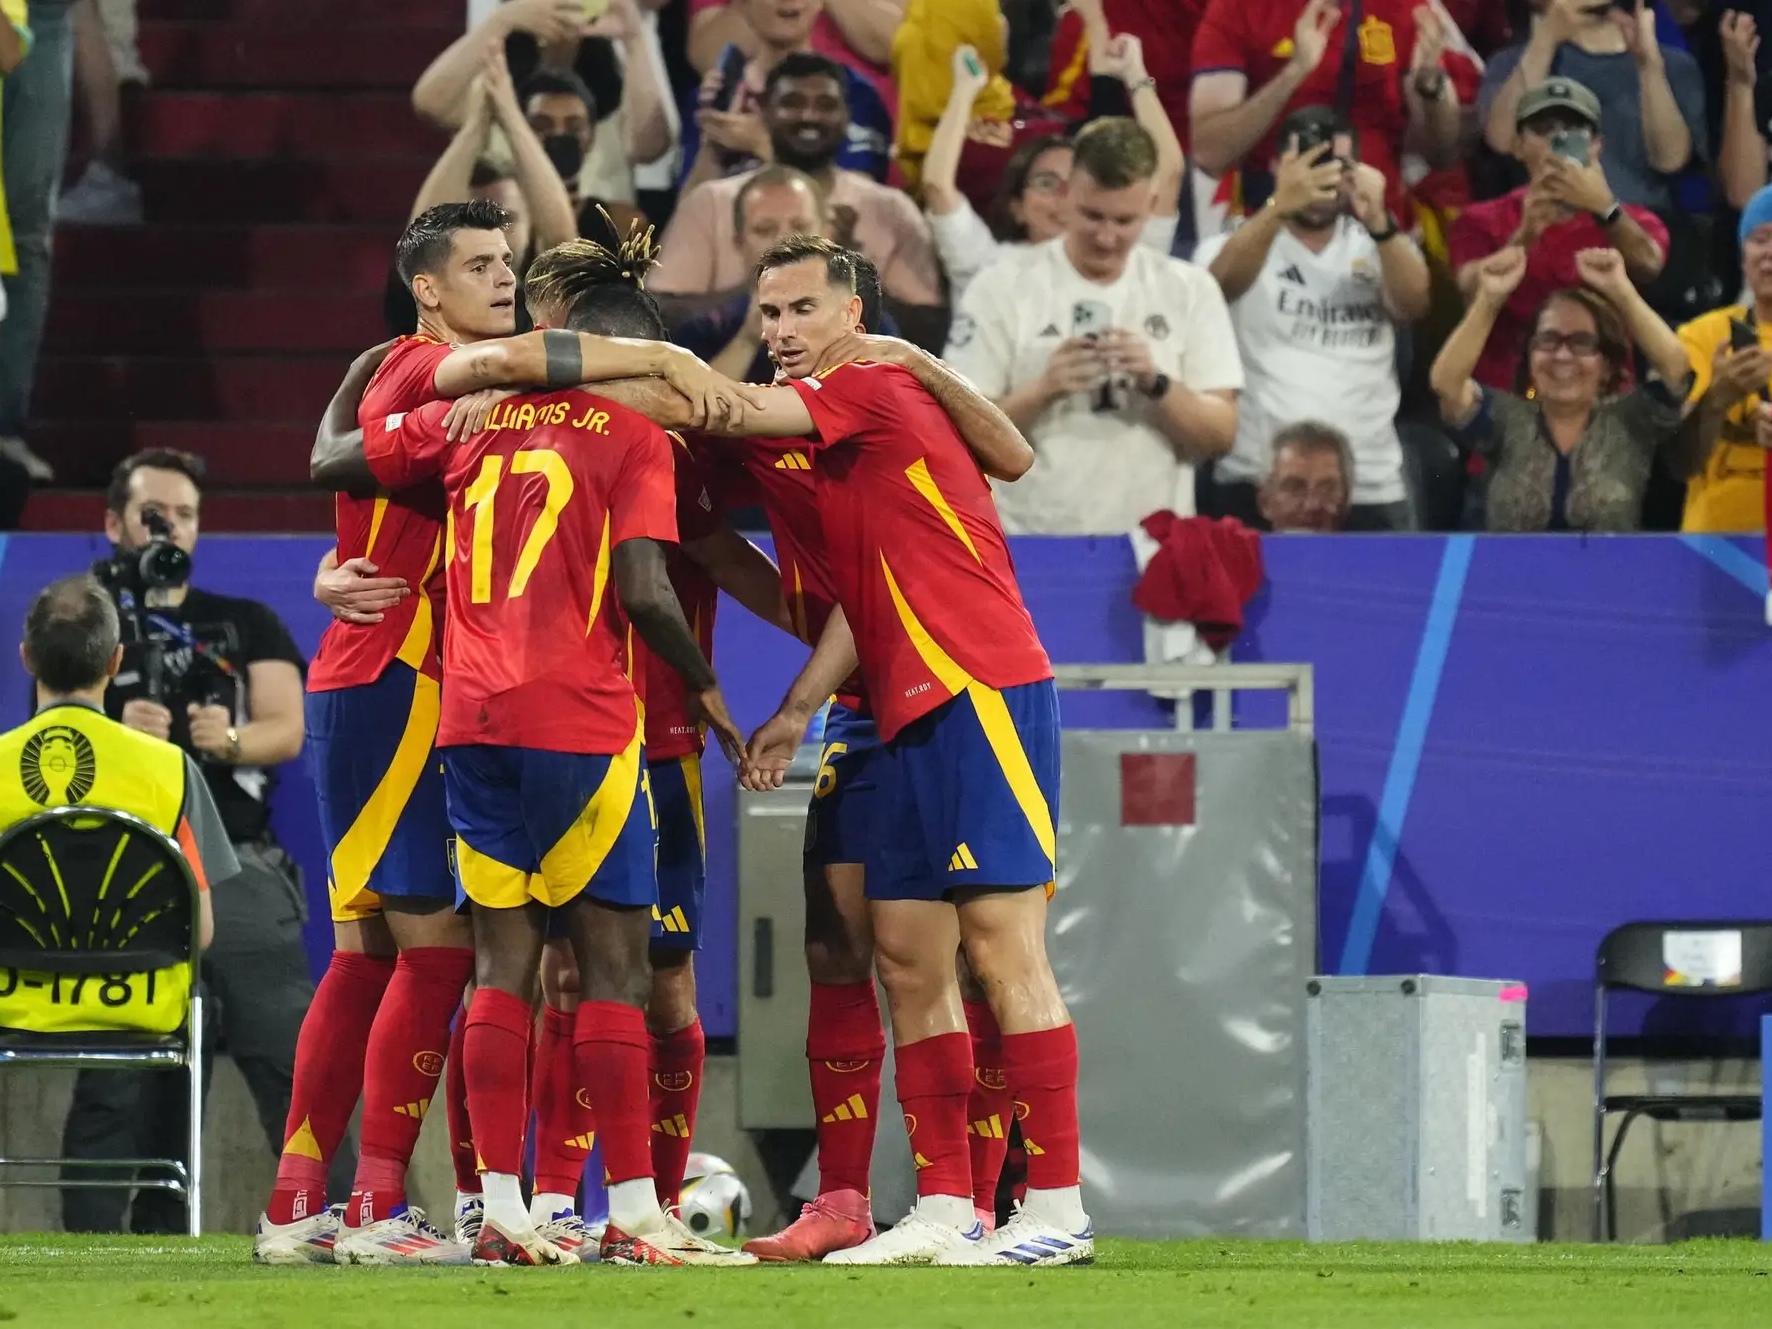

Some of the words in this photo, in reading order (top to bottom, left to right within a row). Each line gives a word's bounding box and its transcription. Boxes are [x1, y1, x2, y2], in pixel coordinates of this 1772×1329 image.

[484, 402, 570, 431] ILLIAMS
[572, 407, 610, 436] JR.
[464, 449, 574, 604] 17
